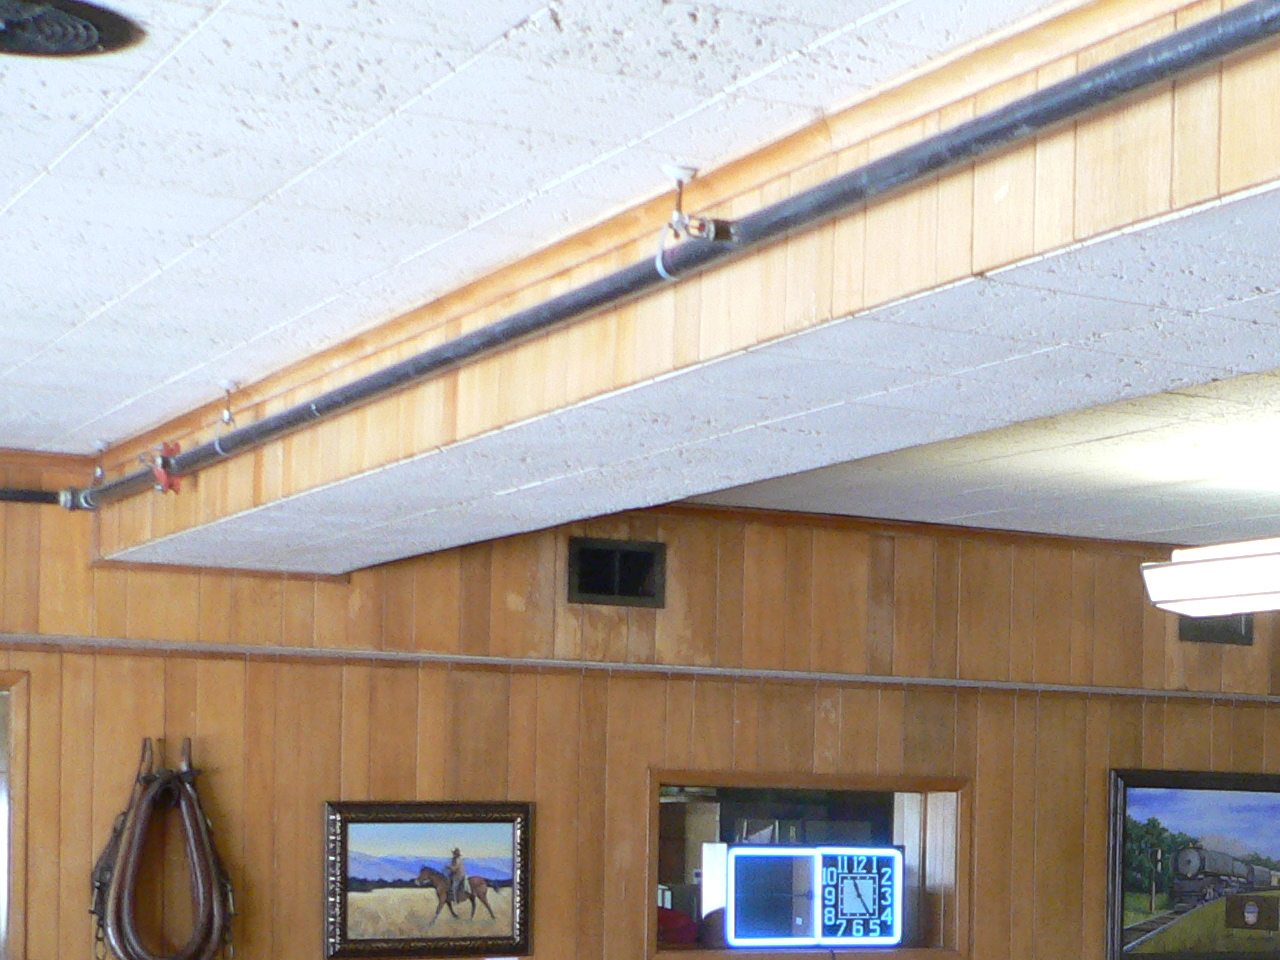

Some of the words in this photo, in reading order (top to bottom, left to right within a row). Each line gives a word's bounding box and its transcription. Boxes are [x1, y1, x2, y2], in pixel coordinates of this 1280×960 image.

[838, 856, 848, 873] 11
[853, 856, 867, 873] 12
[872, 856, 877, 873] 1
[823, 867, 837, 885] 10
[880, 867, 892, 885] 2
[824, 887, 836, 905] 9
[880, 887, 892, 905] 3
[824, 907, 836, 925] 8
[880, 907, 892, 925] 4
[836, 920, 847, 936] 7
[852, 920, 864, 936] 6
[869, 920, 881, 936] 5
